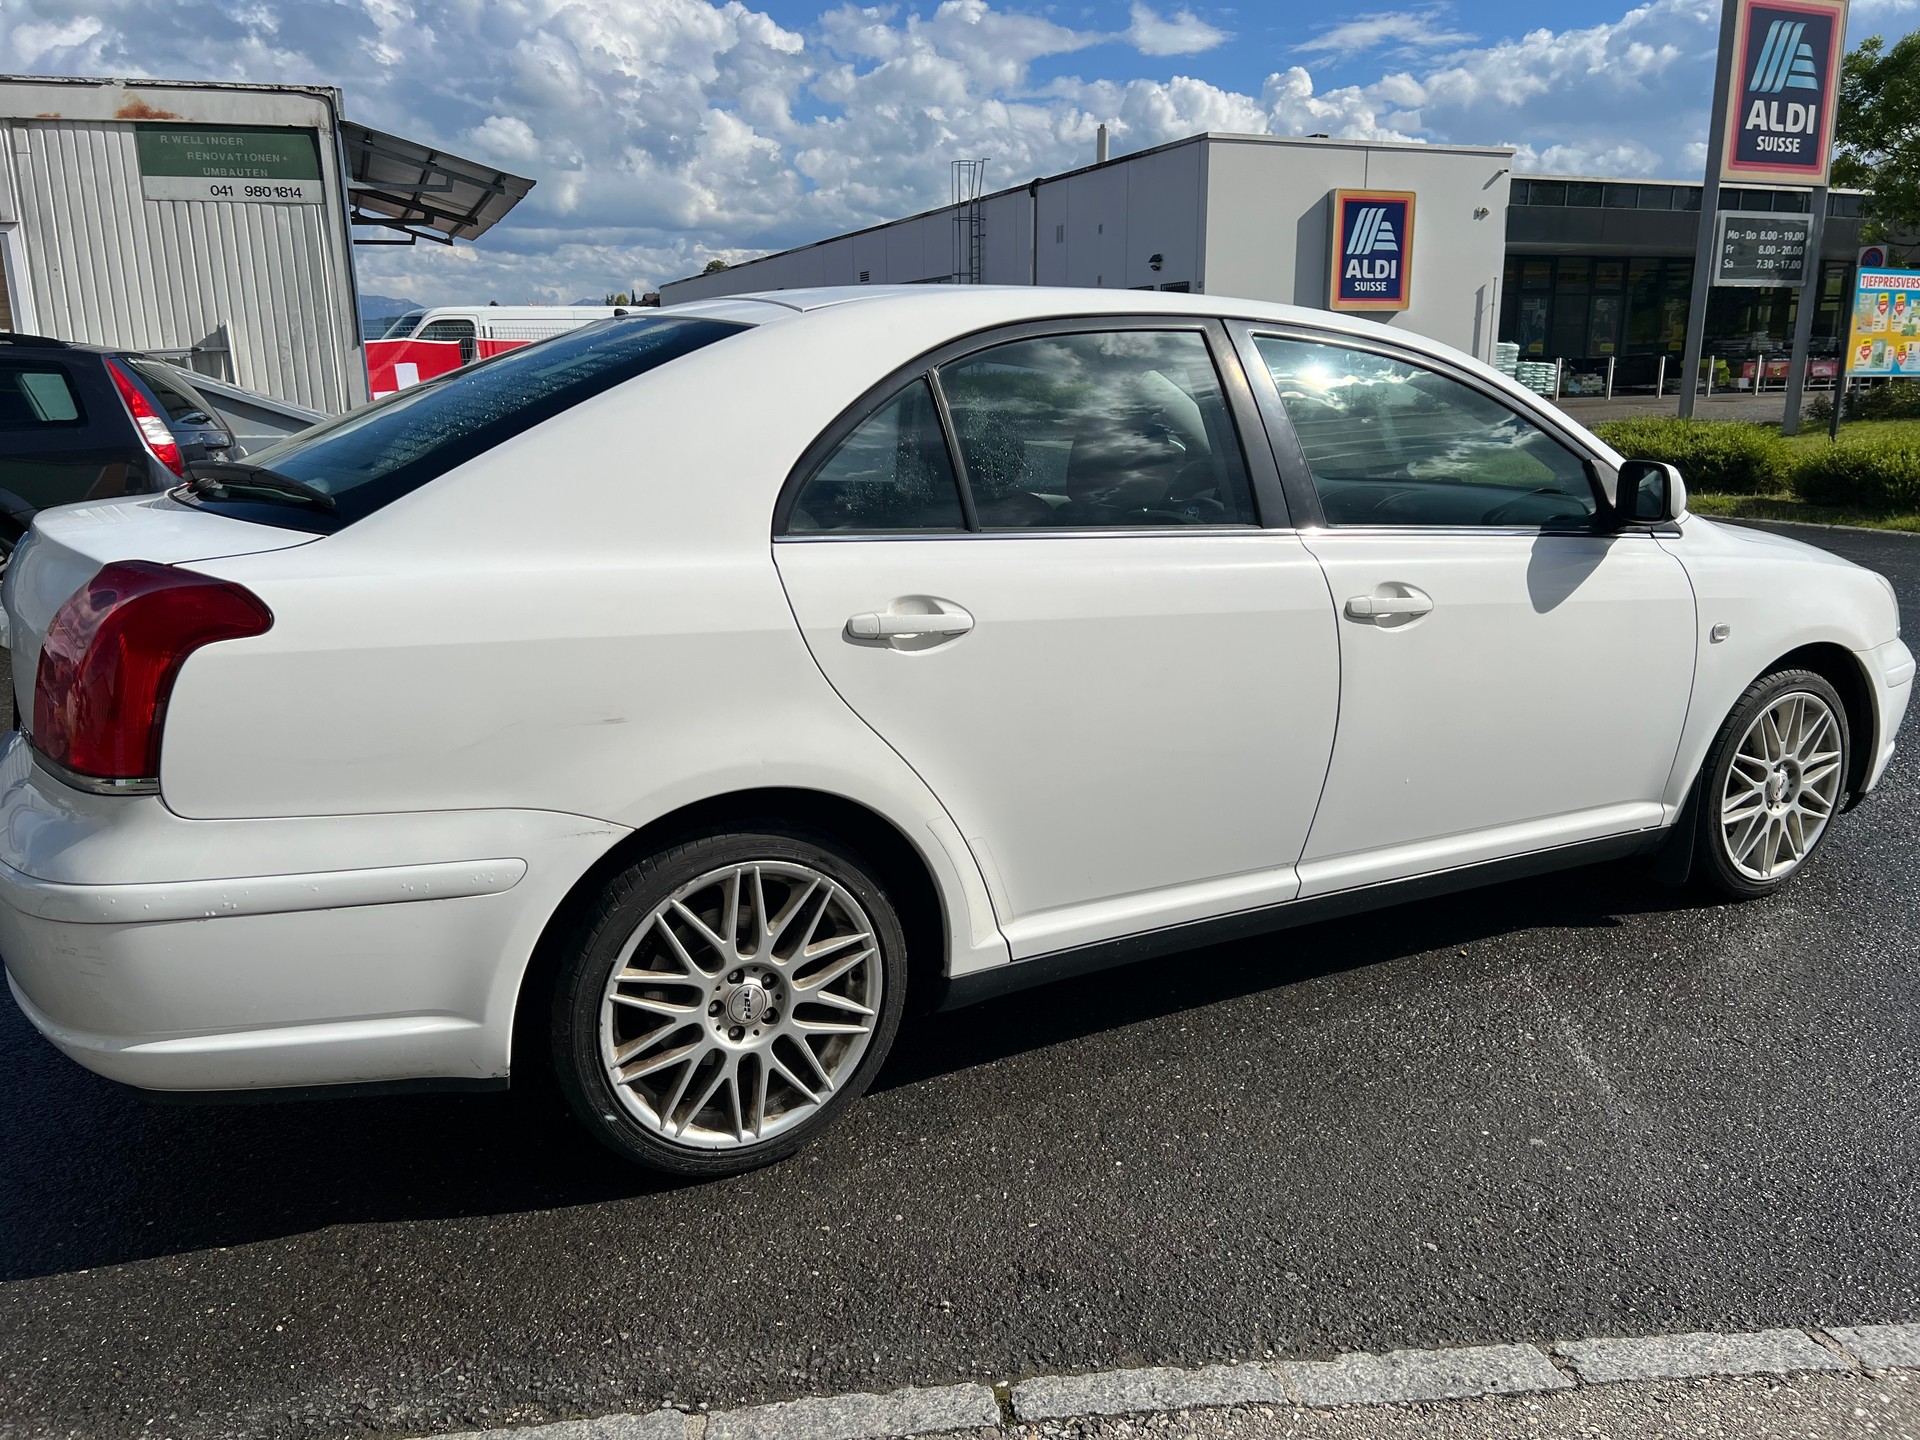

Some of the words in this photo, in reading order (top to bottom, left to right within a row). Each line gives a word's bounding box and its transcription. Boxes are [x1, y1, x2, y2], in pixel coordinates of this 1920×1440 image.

[1745, 99, 1816, 134] ALDI
[1756, 135, 1801, 153] SUISSE
[187, 151, 280, 162] RENOVATIONEN
[203, 167, 268, 177] UMBAUTEN
[210, 185, 234, 196] 041
[1727, 230, 1740, 240] Mo
[1746, 230, 1757, 240] Do
[1760, 231, 1778, 241] 8.00
[1784, 231, 1805, 241] 19.00
[1725, 244, 1734, 254] Fr
[1758, 245, 1776, 255] 8.00
[1781, 245, 1803, 256] 20.00
[1345, 258, 1397, 279] ALDI
[1723, 259, 1734, 269] Sa
[1756, 260, 1774, 269] 7.30
[1780, 260, 1802, 270] 17.00
[1354, 281, 1387, 292] SUISSE
